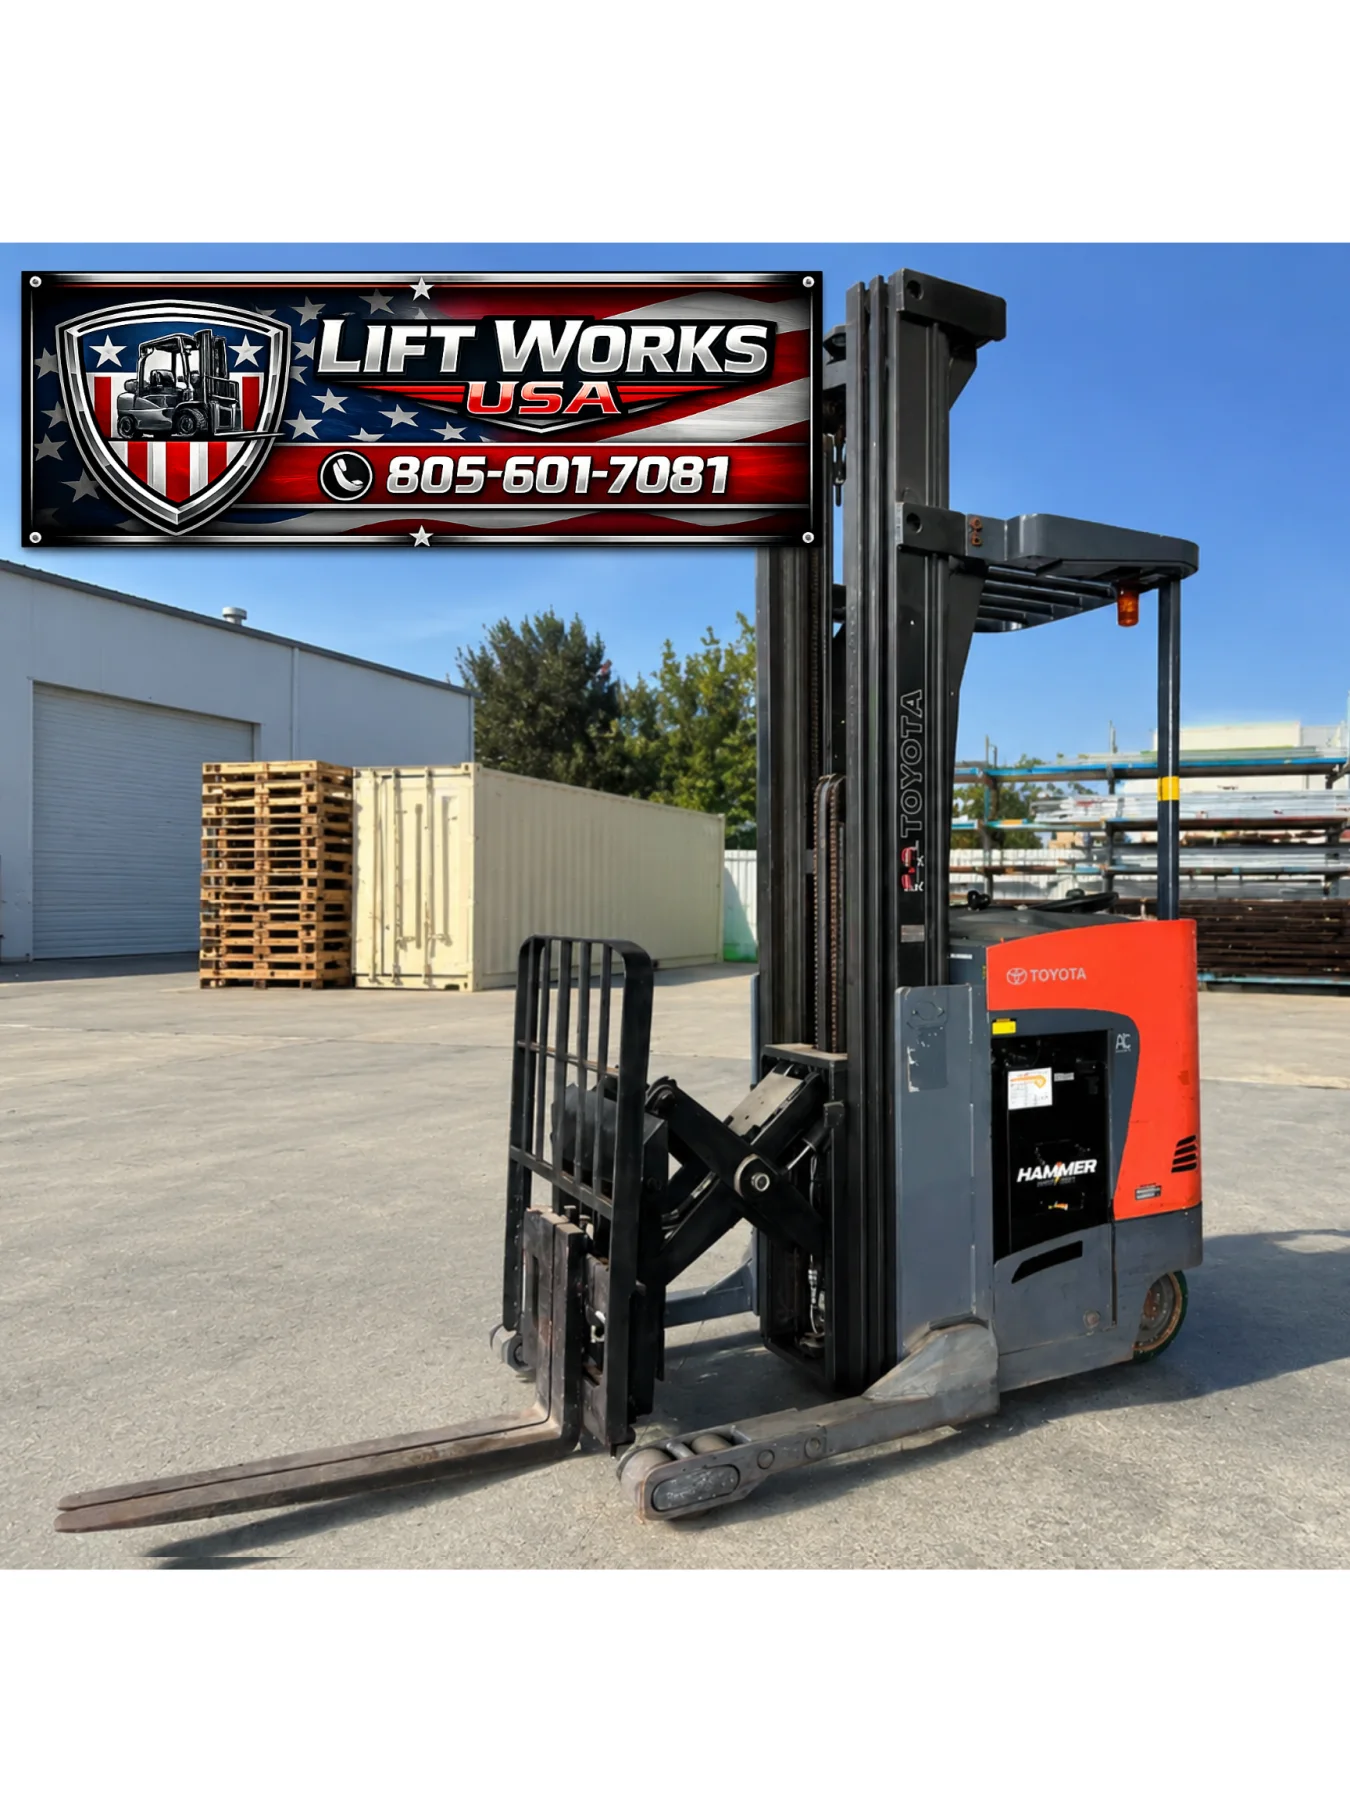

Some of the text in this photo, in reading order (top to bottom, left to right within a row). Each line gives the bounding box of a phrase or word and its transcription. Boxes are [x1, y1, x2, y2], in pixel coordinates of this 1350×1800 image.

[900, 689, 923, 838] TOYOTA
[1029, 967, 1087, 981] TOYOTA
[1016, 1159, 1097, 1182] HAMMER
